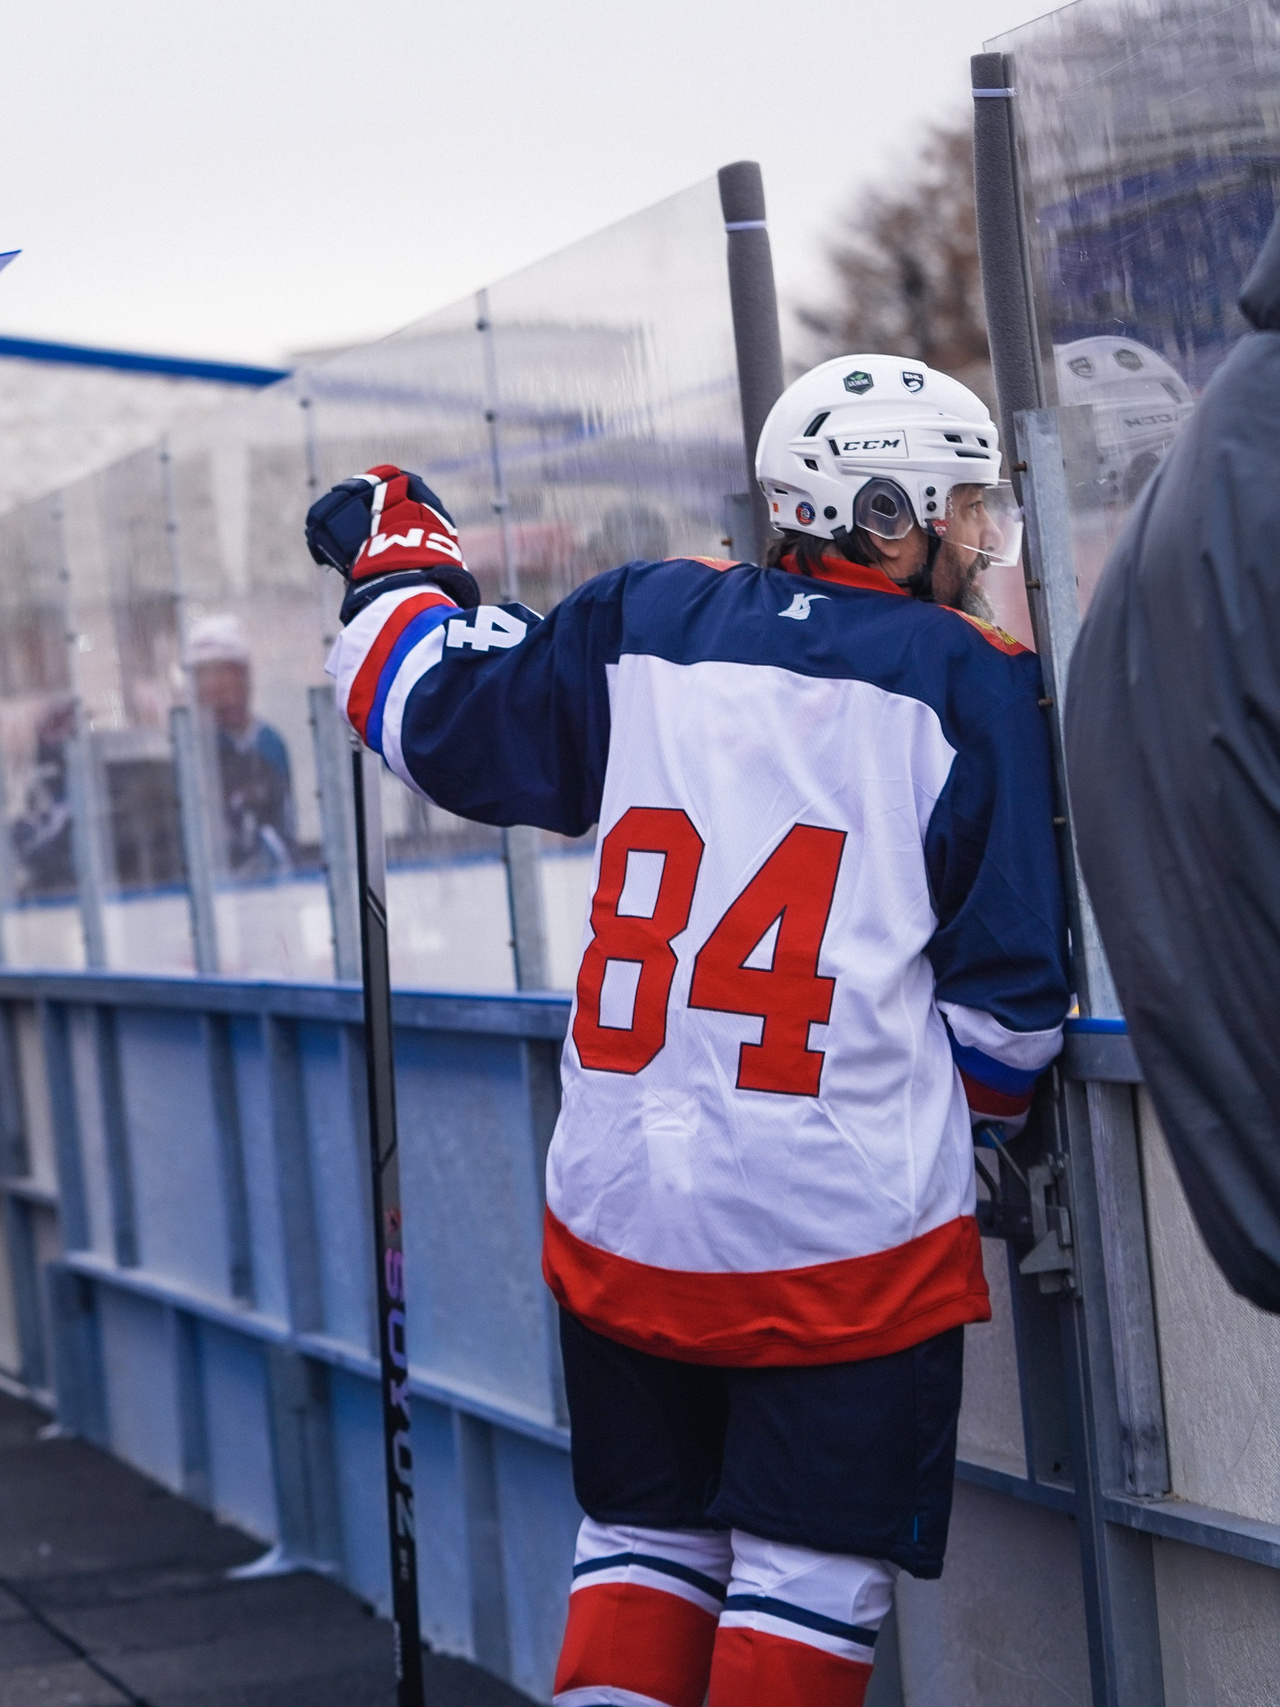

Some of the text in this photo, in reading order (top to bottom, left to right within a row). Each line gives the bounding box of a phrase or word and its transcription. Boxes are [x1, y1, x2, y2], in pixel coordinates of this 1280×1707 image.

[843, 439, 901, 451] CCM
[367, 528, 468, 571] CM
[572, 806, 848, 1098] 84
